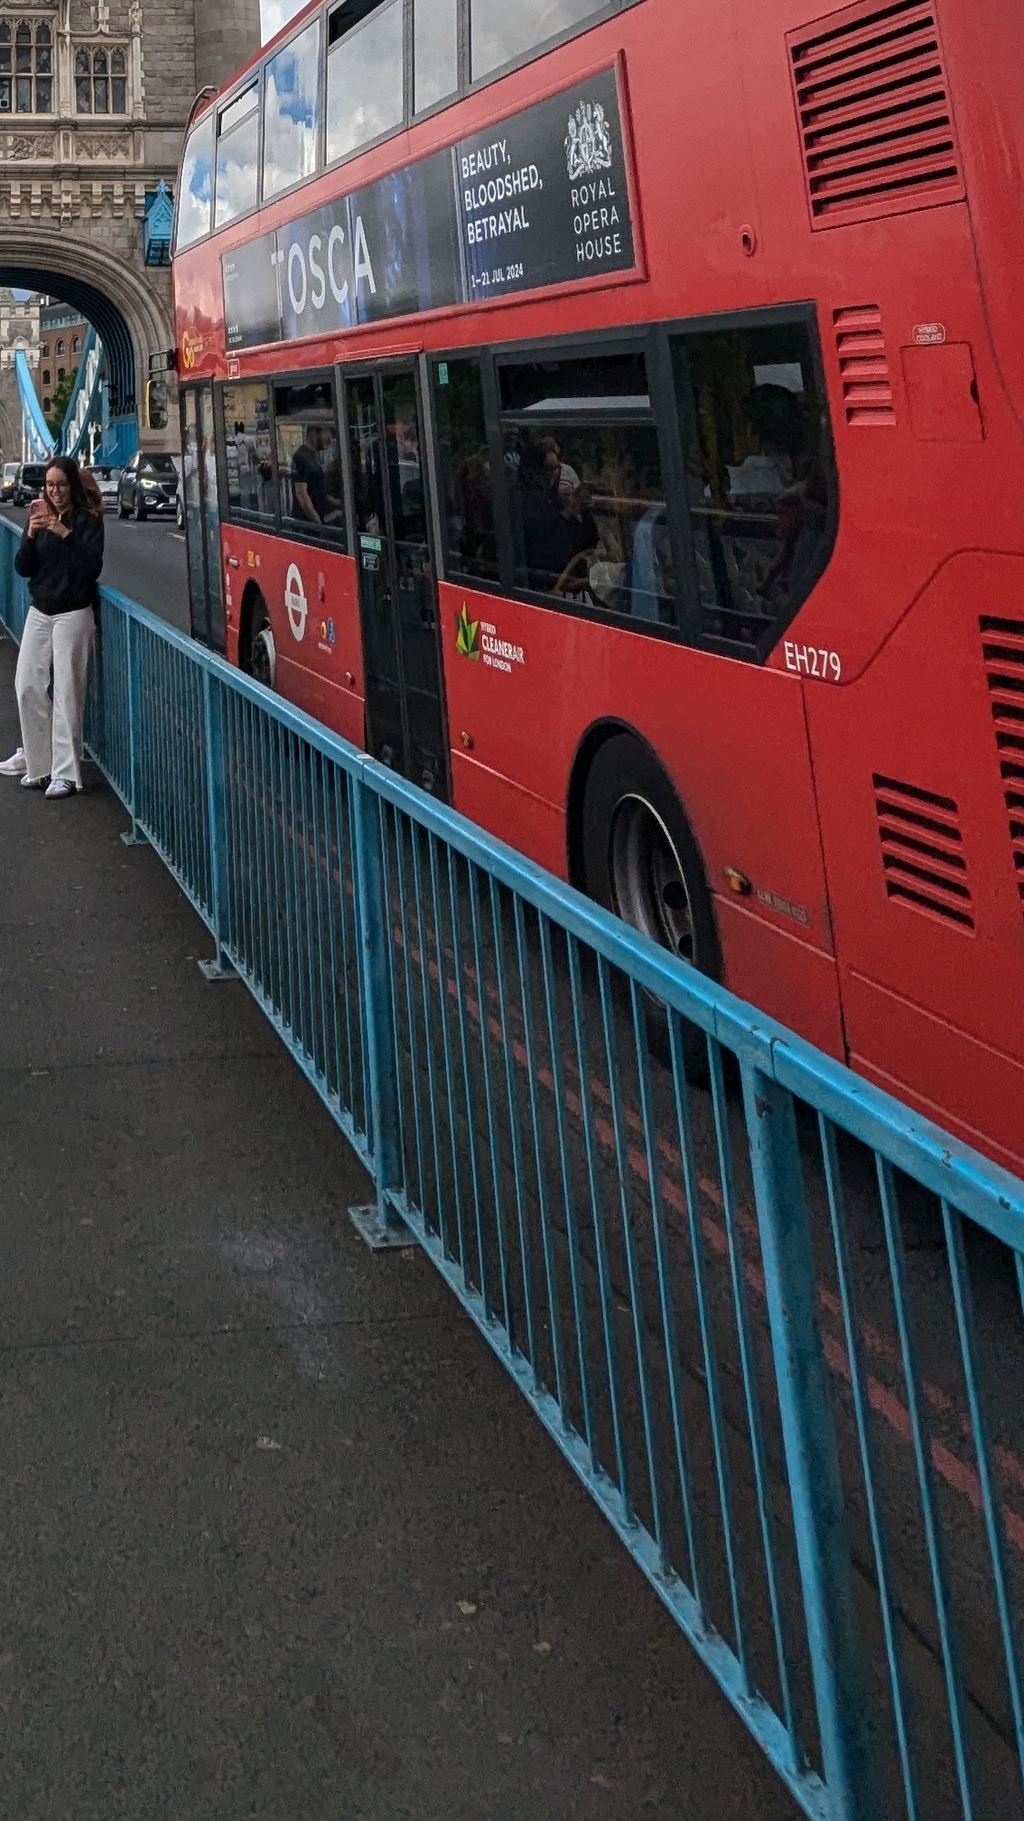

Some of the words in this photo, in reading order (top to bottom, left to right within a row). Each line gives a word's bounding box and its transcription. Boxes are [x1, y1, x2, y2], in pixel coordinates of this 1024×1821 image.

[461, 139, 511, 179] BEAUTY,
[464, 164, 544, 211] BLOODSHED,
[571, 177, 616, 208] ROYAL
[467, 206, 530, 245] BETRAYAL
[573, 205, 620, 234] OPERA
[271, 215, 377, 314] TOSCA
[577, 233, 622, 262] HOUSE
[491, 268, 505, 283] JUL
[506, 263, 524, 279] 2024
[784, 641, 841, 681] EH279
